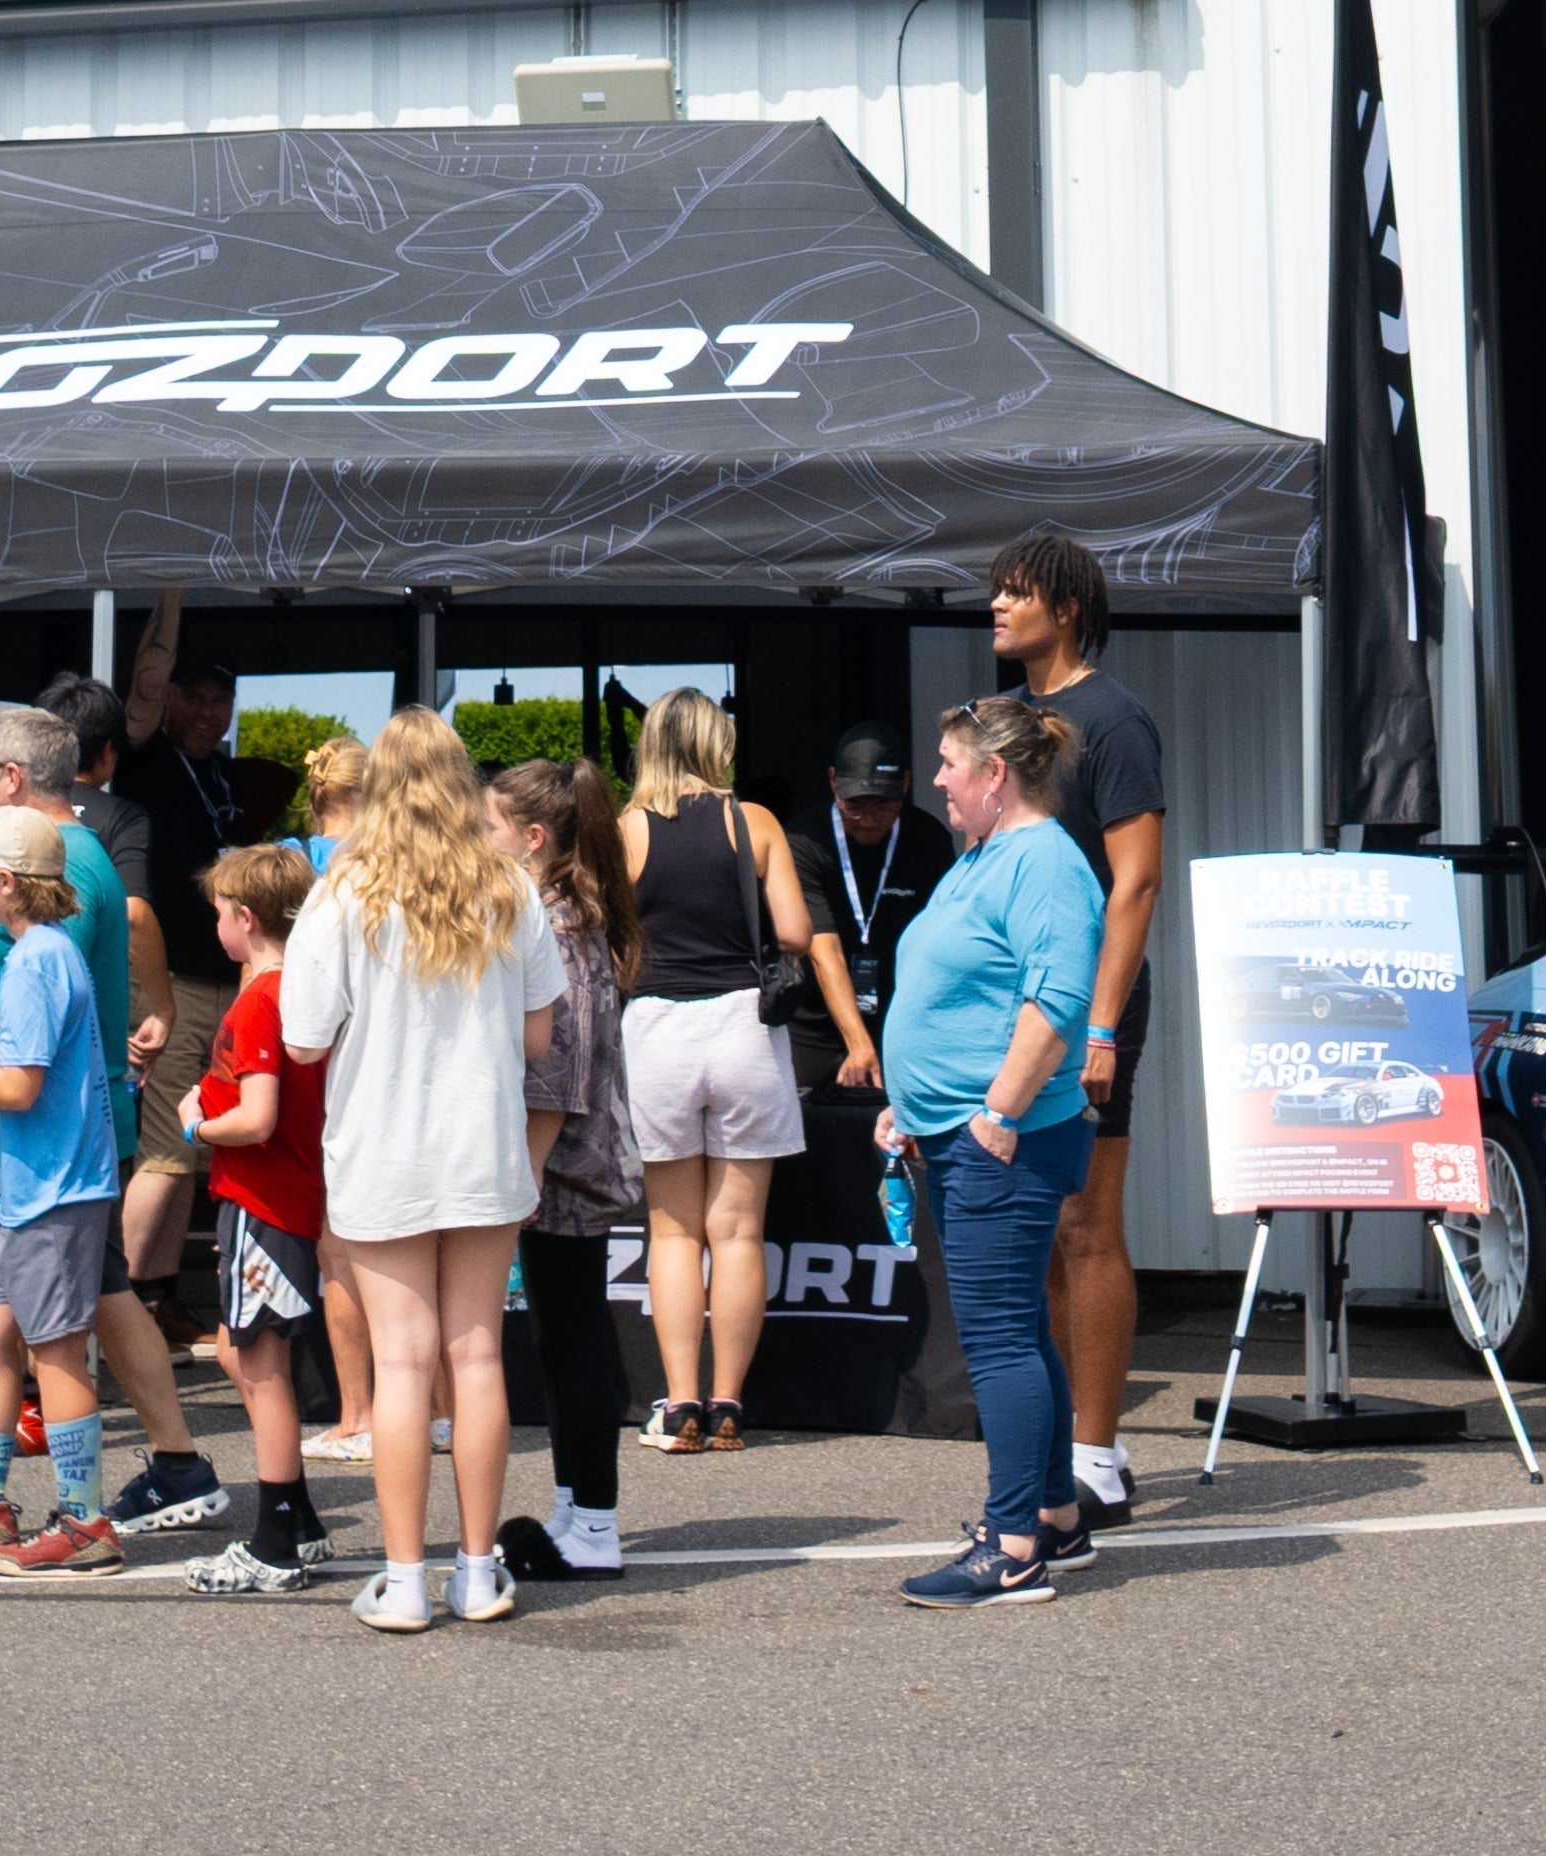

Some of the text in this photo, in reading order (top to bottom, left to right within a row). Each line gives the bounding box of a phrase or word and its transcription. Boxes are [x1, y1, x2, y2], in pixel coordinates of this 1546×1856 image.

[1259, 867, 1391, 893] RAFFLE
[1243, 892, 1411, 918] CONTEST
[1294, 947, 1454, 973] TRACK RIDE
[1360, 967, 1456, 993] ALONG
[1230, 1041, 1390, 1066] $500 GIFT
[1233, 1063, 1320, 1089] CARD
